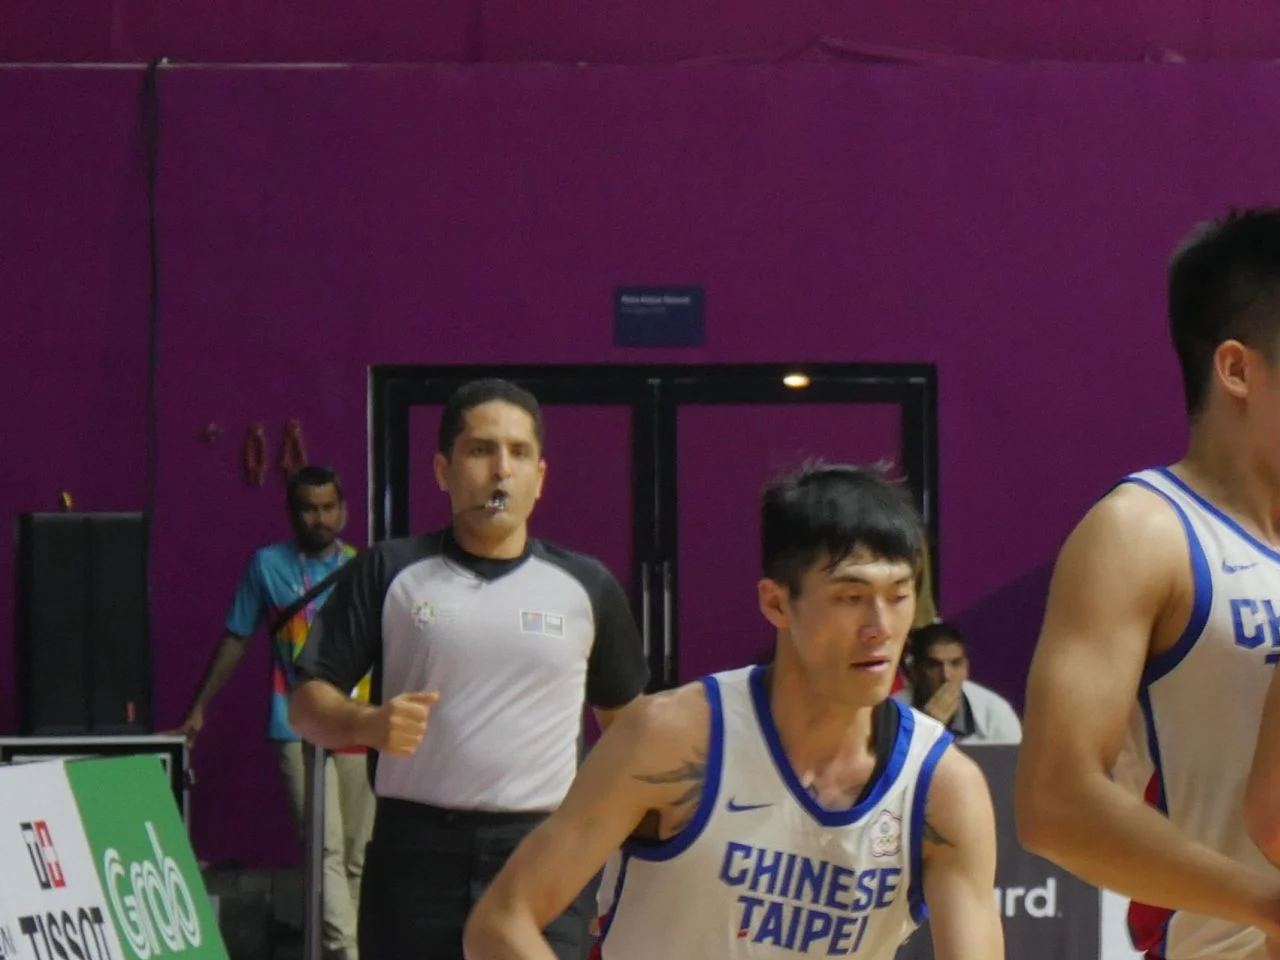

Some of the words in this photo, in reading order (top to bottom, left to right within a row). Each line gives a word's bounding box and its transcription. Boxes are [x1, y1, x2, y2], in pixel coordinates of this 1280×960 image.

[104, 821, 201, 960] Grab
[719, 841, 904, 913] CHINESE
[736, 895, 869, 956] TAIPEI
